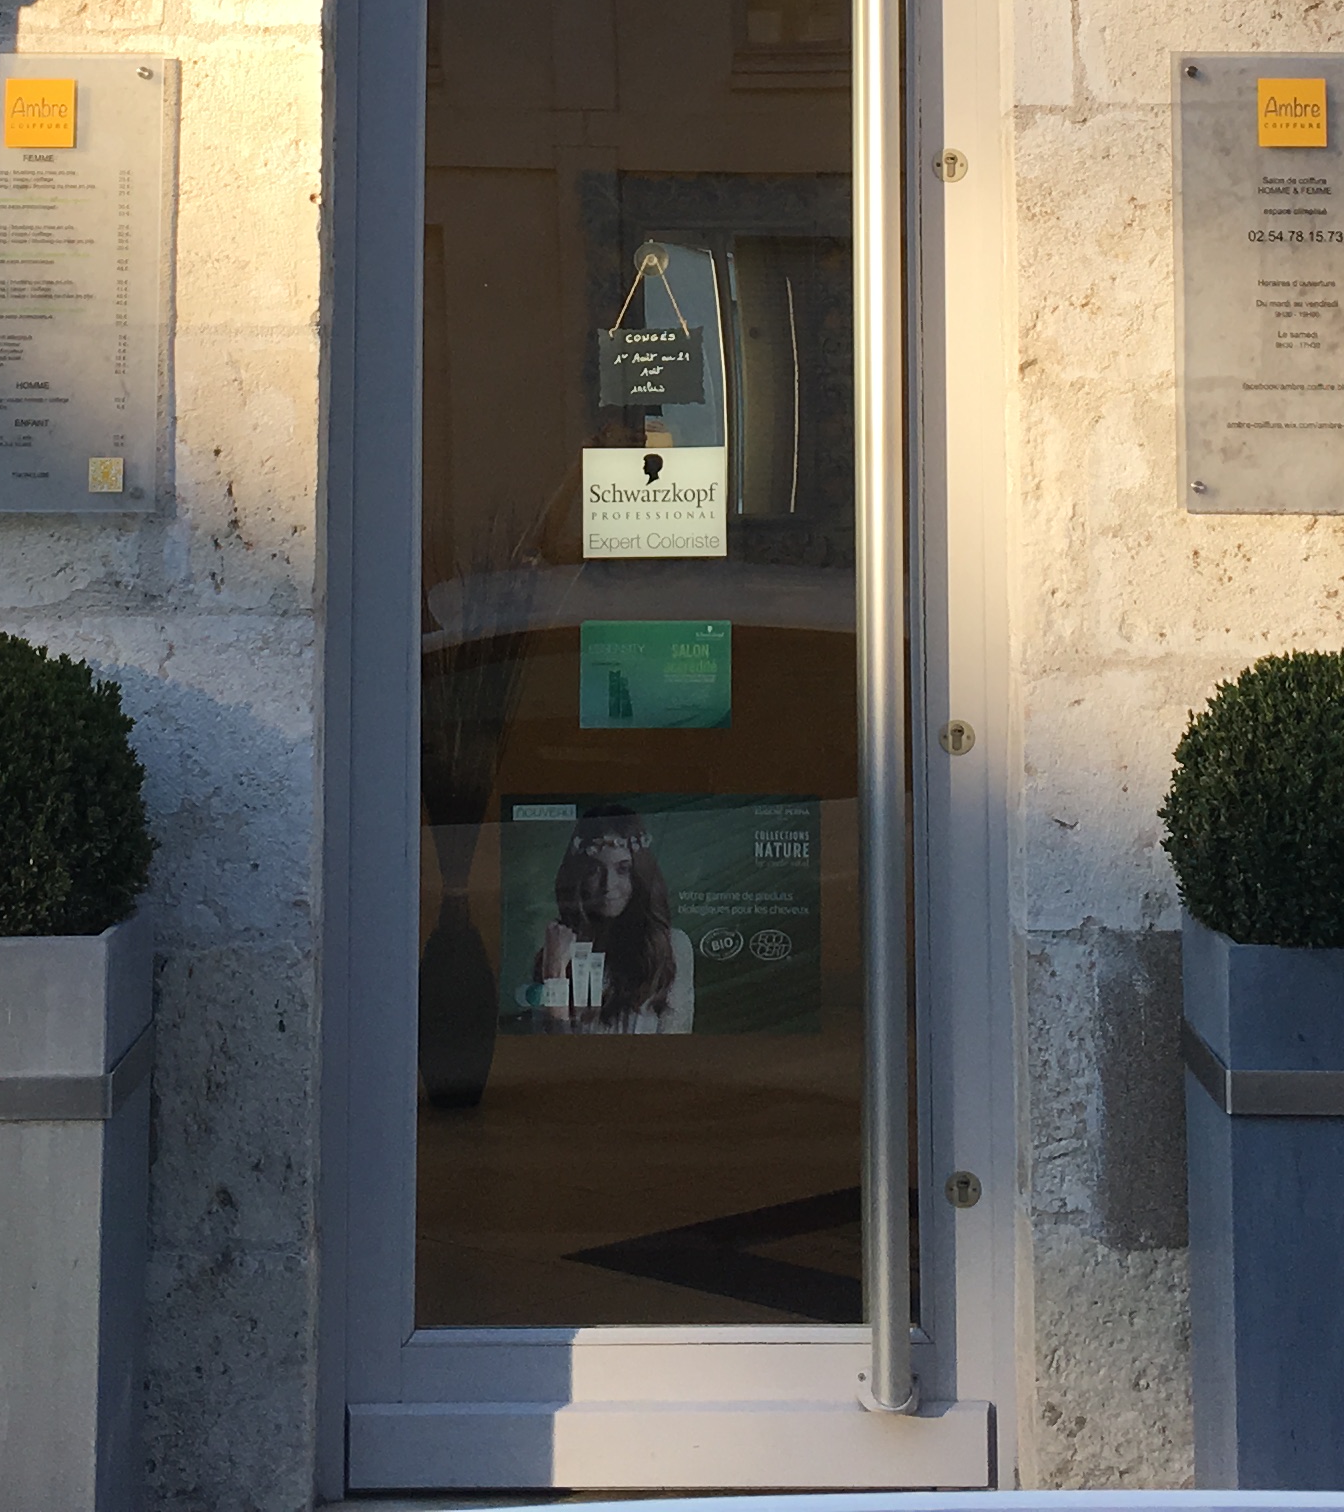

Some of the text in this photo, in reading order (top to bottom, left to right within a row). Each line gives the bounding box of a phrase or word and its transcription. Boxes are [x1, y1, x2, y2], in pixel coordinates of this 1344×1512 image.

[10, 96, 69, 119] Ambre
[1264, 96, 1321, 118] Ambre
[22, 154, 55, 163] FEMME
[1262, 176, 1285, 185] Salon
[1286, 177, 1297, 185] de
[1258, 186, 1291, 195] HOMME
[1300, 186, 1332, 195] FEMME
[1248, 230, 1344, 243] 02.54.78.15.73
[1257, 279, 1291, 288] Horaires
[1256, 299, 1268, 308] Du
[1277, 330, 1288, 339] Le
[15, 381, 50, 390] HOMME
[589, 482, 719, 508] Schwarzkopf
[591, 511, 716, 521] PROFESSIONAL
[589, 532, 720, 552] Expert Coloriste
[671, 643, 710, 659] SALON
[754, 830, 810, 841] COLLECTIONS
[754, 841, 810, 858] NATURE
[678, 891, 794, 903] Votre gamme de produits
[731, 907, 754, 916] pour
[754, 905, 768, 914] les
[769, 905, 810, 915] cheveux
[710, 937, 734, 952] BIO
